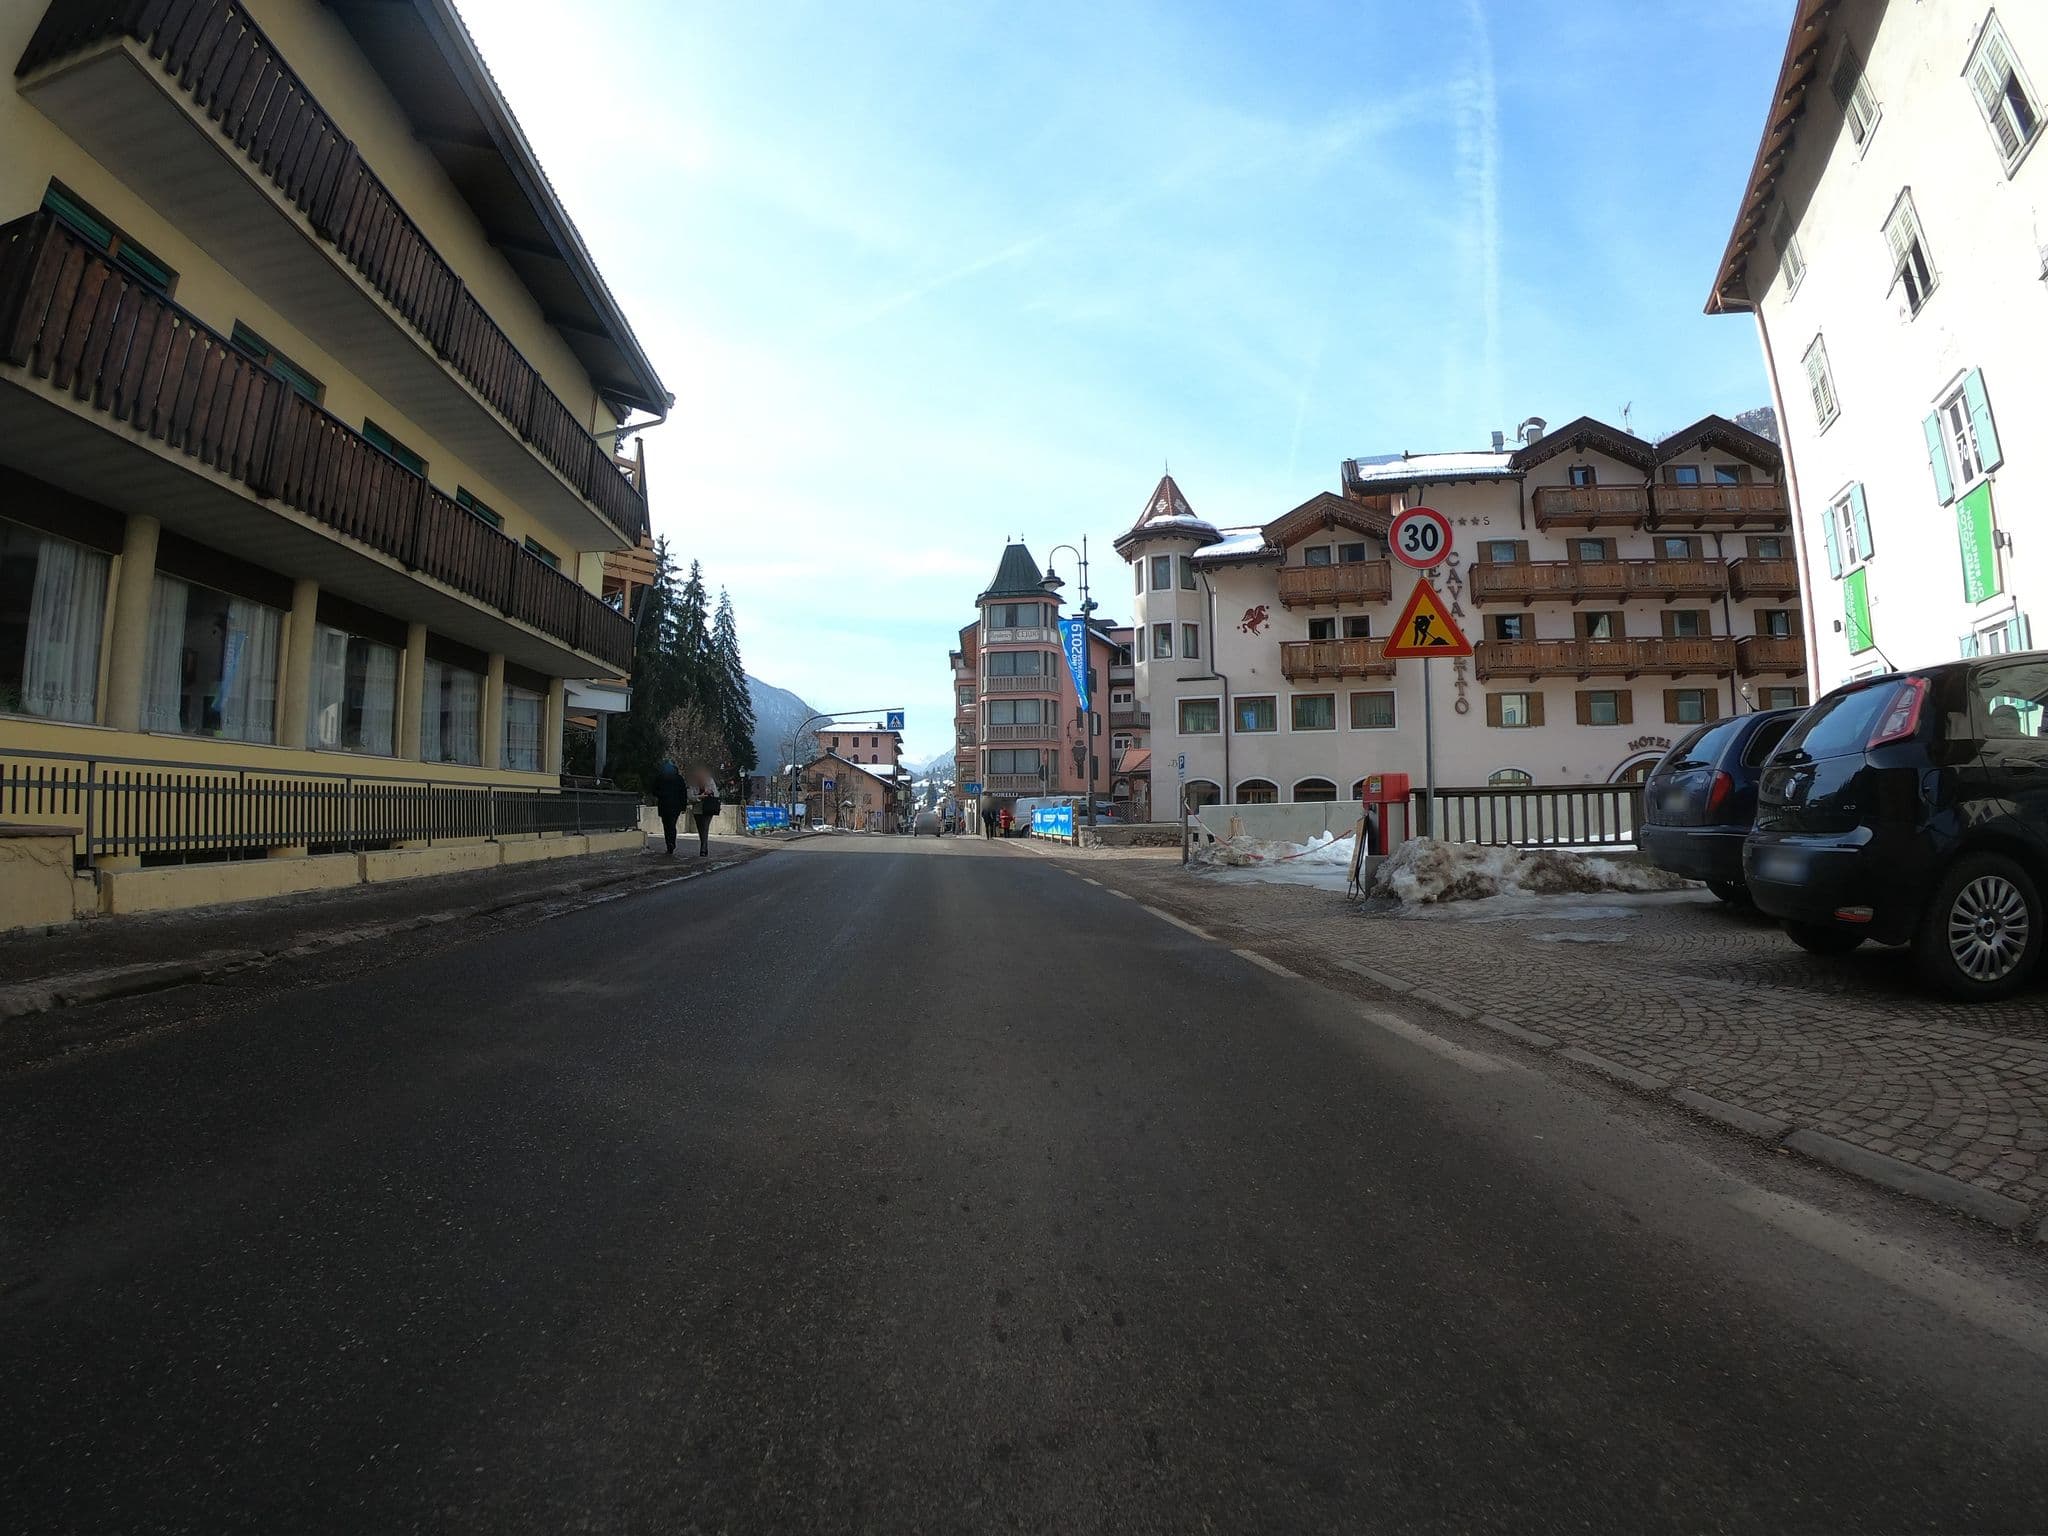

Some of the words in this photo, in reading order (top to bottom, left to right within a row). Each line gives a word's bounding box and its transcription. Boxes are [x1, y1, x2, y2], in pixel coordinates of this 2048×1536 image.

[1404, 523, 1439, 552] 30
[1071, 623, 1083, 654] 2019
[1446, 551, 1470, 715] CAVATTO
[1627, 736, 1671, 751] HOTEL
